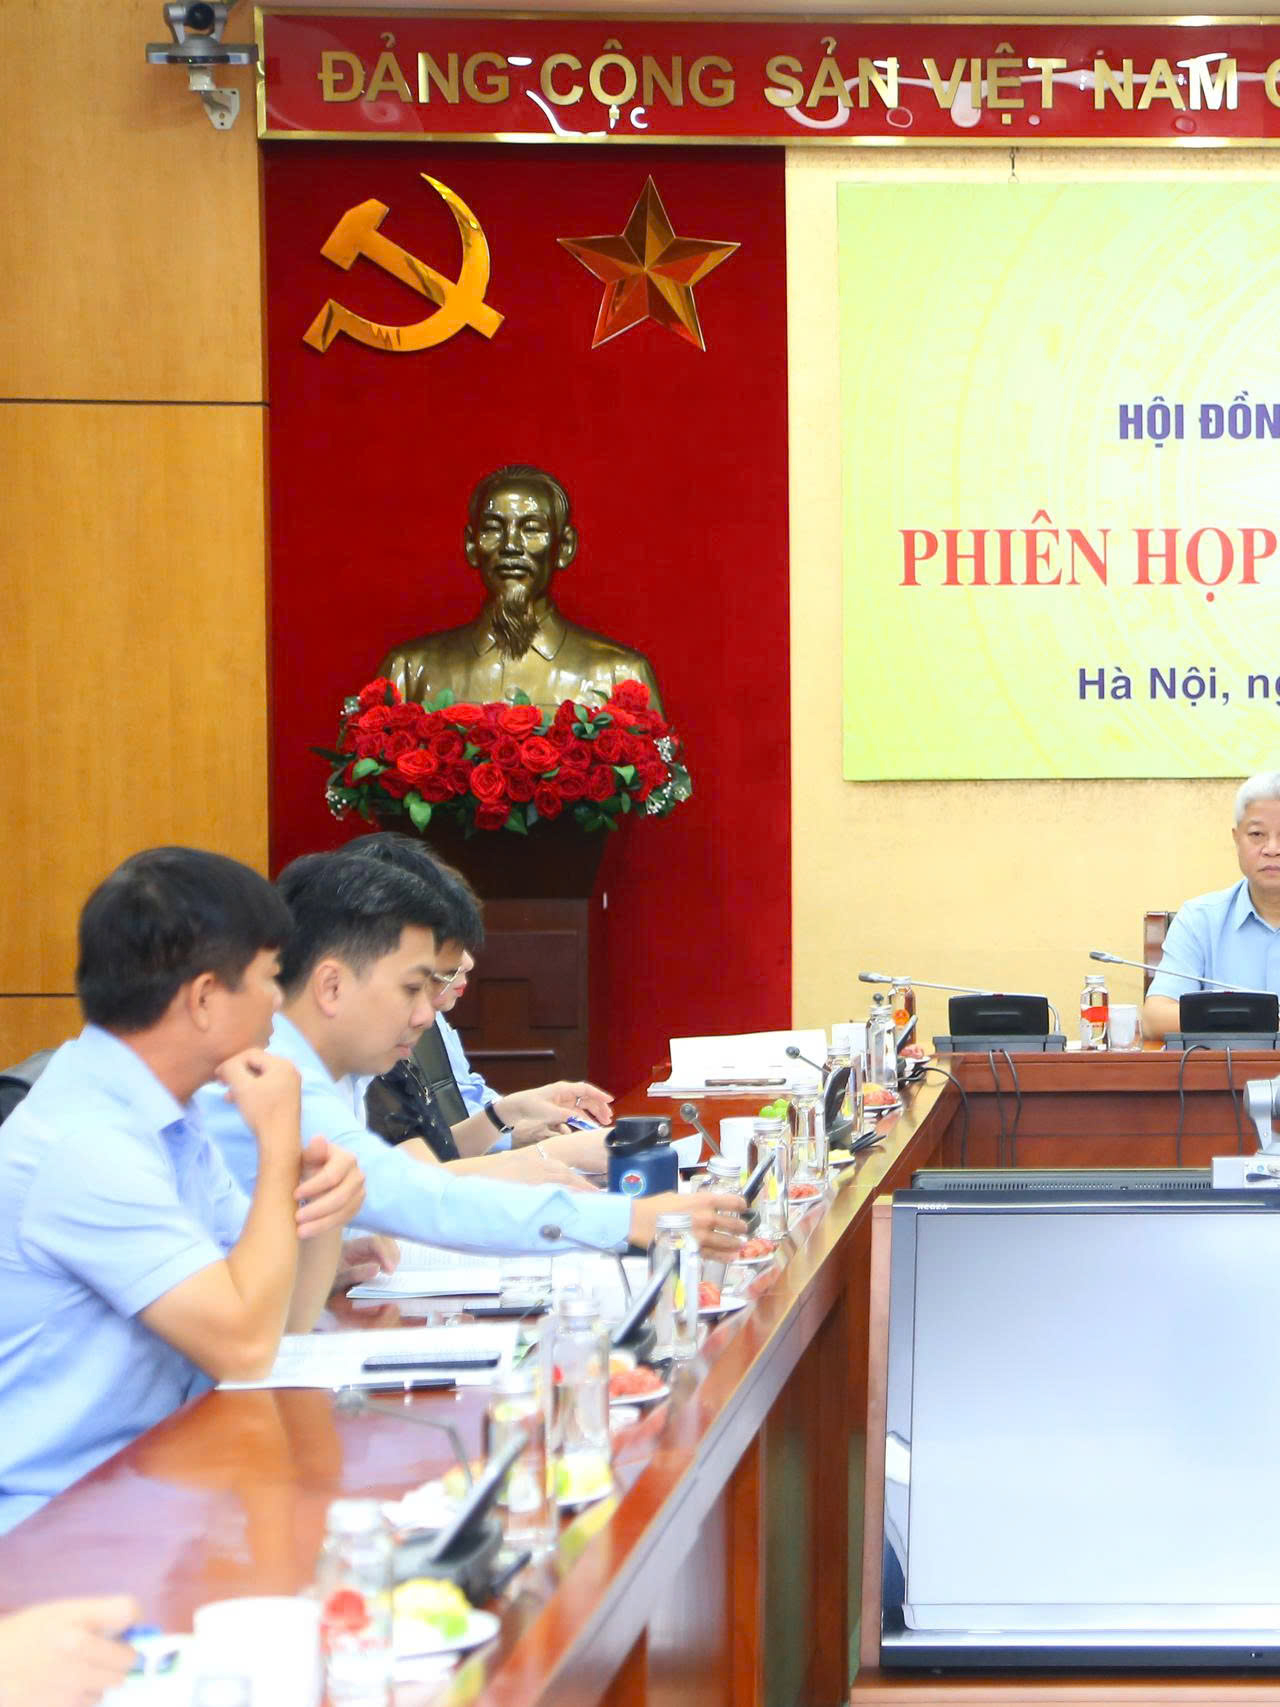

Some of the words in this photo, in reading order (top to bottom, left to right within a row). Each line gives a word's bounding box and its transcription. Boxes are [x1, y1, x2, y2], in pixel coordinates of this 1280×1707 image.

[319, 32, 510, 104] ĐẢNG
[540, 39, 735, 120] CỘNG
[764, 37, 900, 108] SẢN
[922, 43, 1067, 124] VIỆT
[1094, 57, 1239, 110] NAM
[1119, 397, 1184, 447] HỘI
[901, 510, 1109, 586] PHIÊN
[1136, 528, 1277, 602] HỌP
[1079, 666, 1132, 699] Hà
[1150, 667, 1228, 707] Nội,
